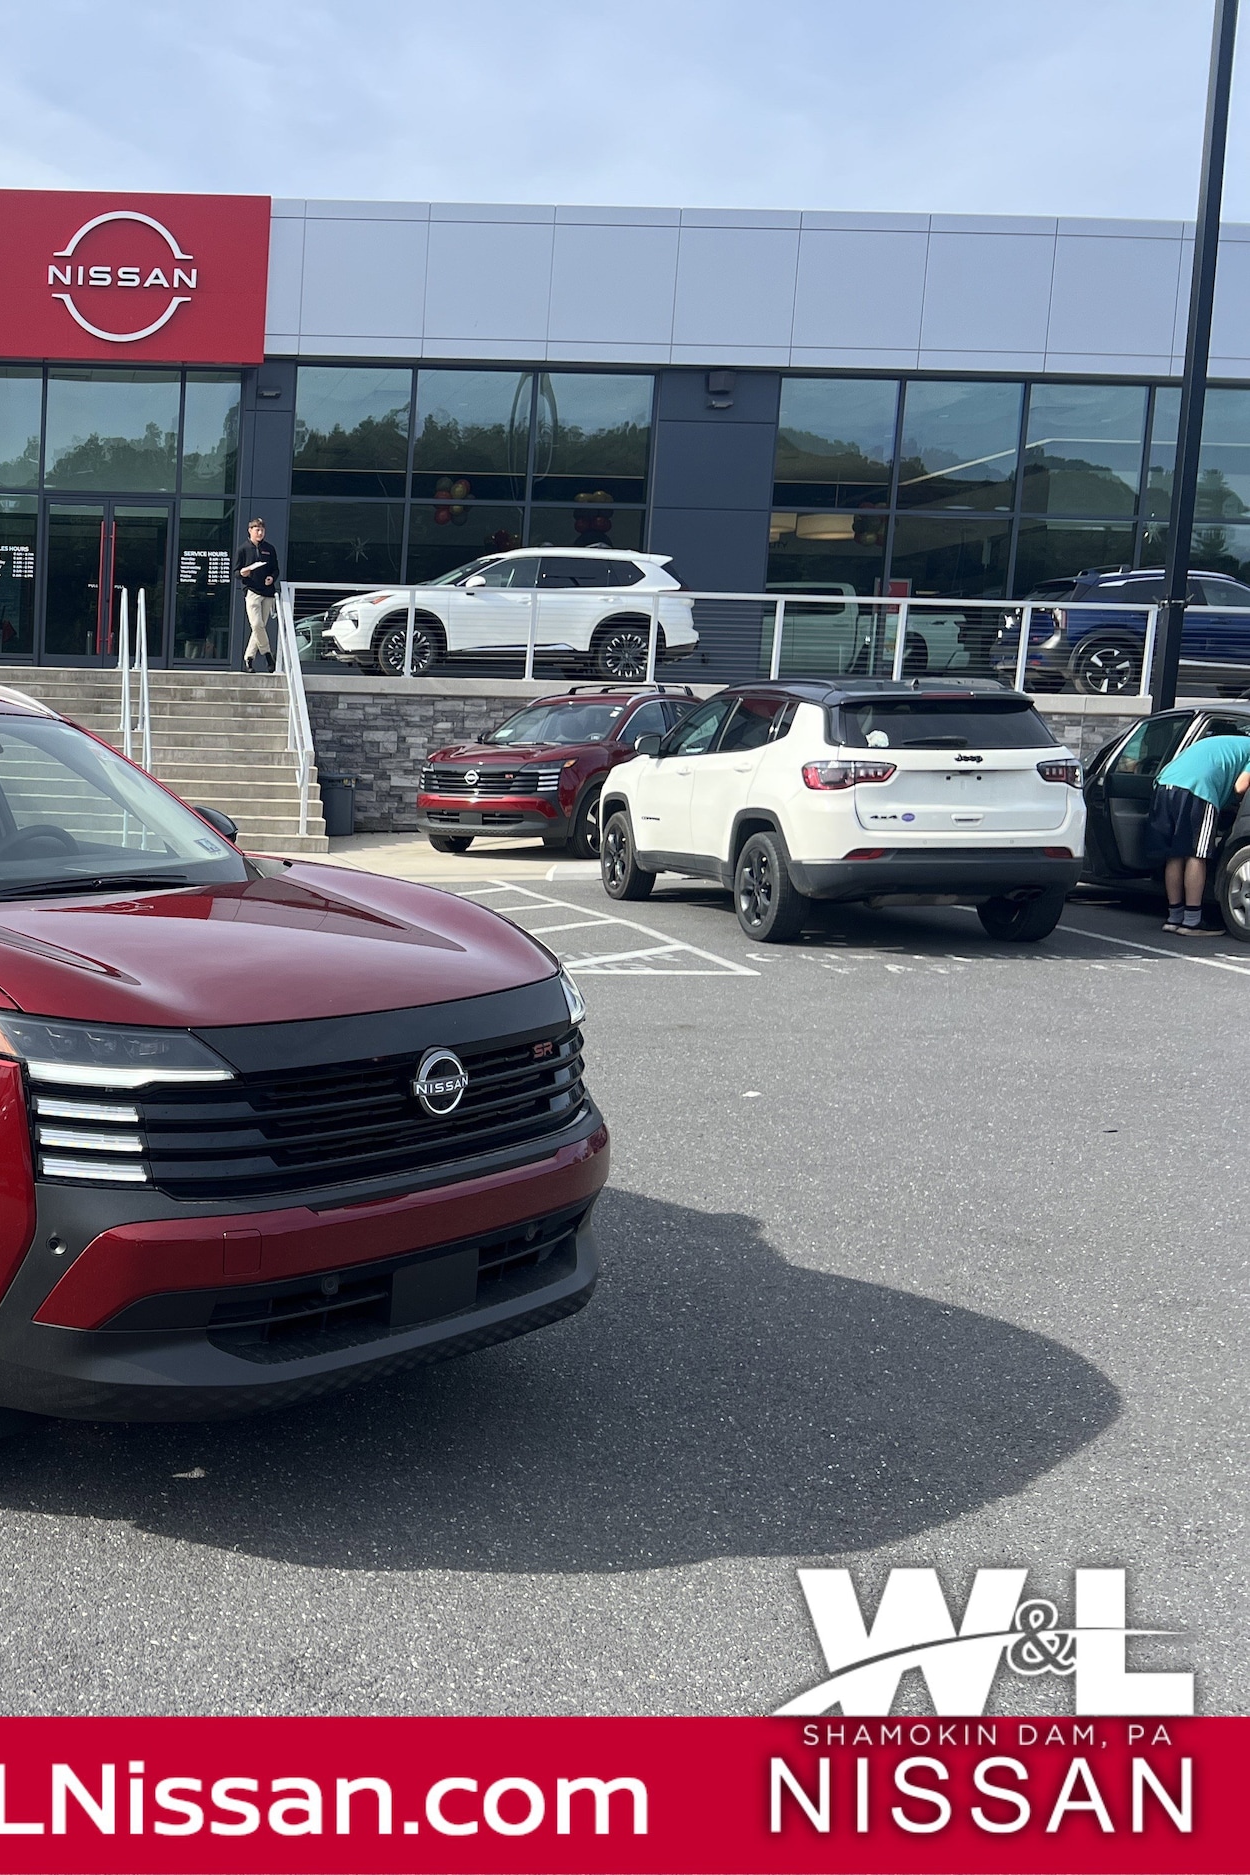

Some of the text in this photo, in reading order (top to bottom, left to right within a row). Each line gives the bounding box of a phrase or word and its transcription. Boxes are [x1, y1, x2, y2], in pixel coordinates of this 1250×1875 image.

[48, 254, 197, 289] NISSAN
[954, 754, 983, 763] Jeep
[533, 1041, 553, 1058] SR
[416, 1075, 469, 1095] NISSAN
